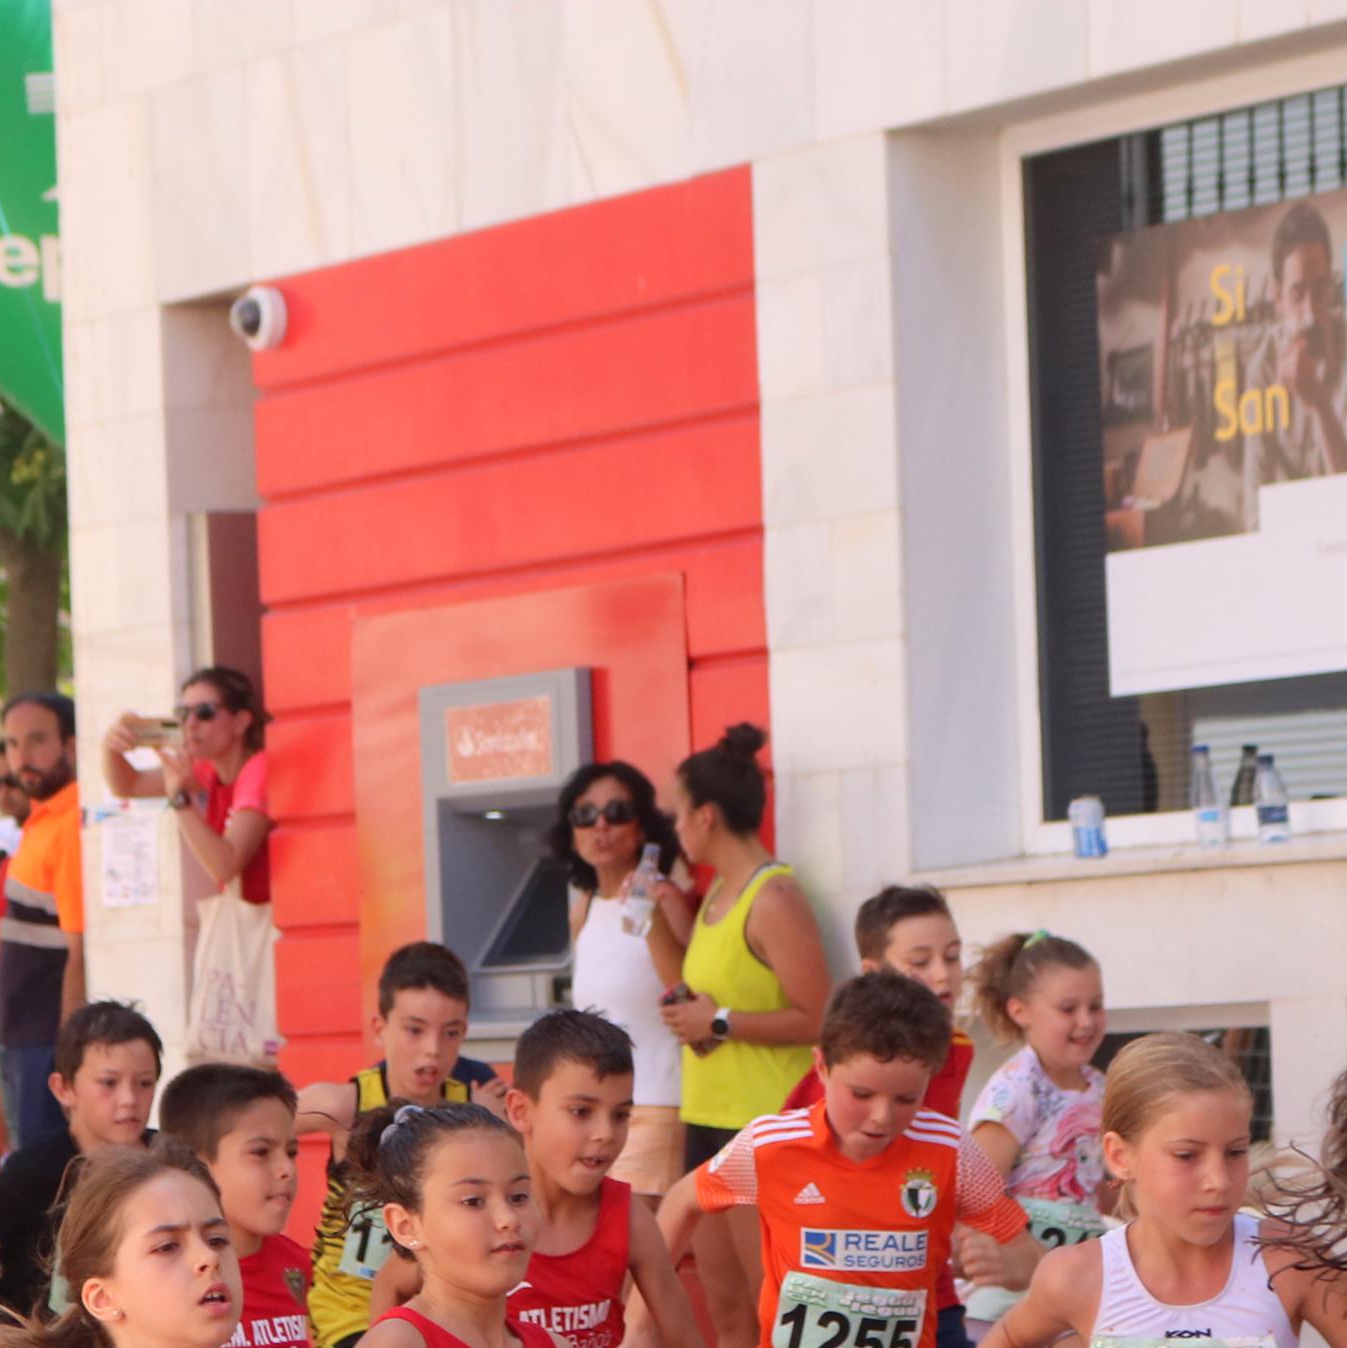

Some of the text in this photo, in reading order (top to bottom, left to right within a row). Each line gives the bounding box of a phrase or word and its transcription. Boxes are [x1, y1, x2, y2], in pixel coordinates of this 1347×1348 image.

[1210, 263, 1245, 326] Si
[1214, 377, 1290, 442] San
[844, 1232, 928, 1251] REALE
[844, 1254, 927, 1269] SEGUROS
